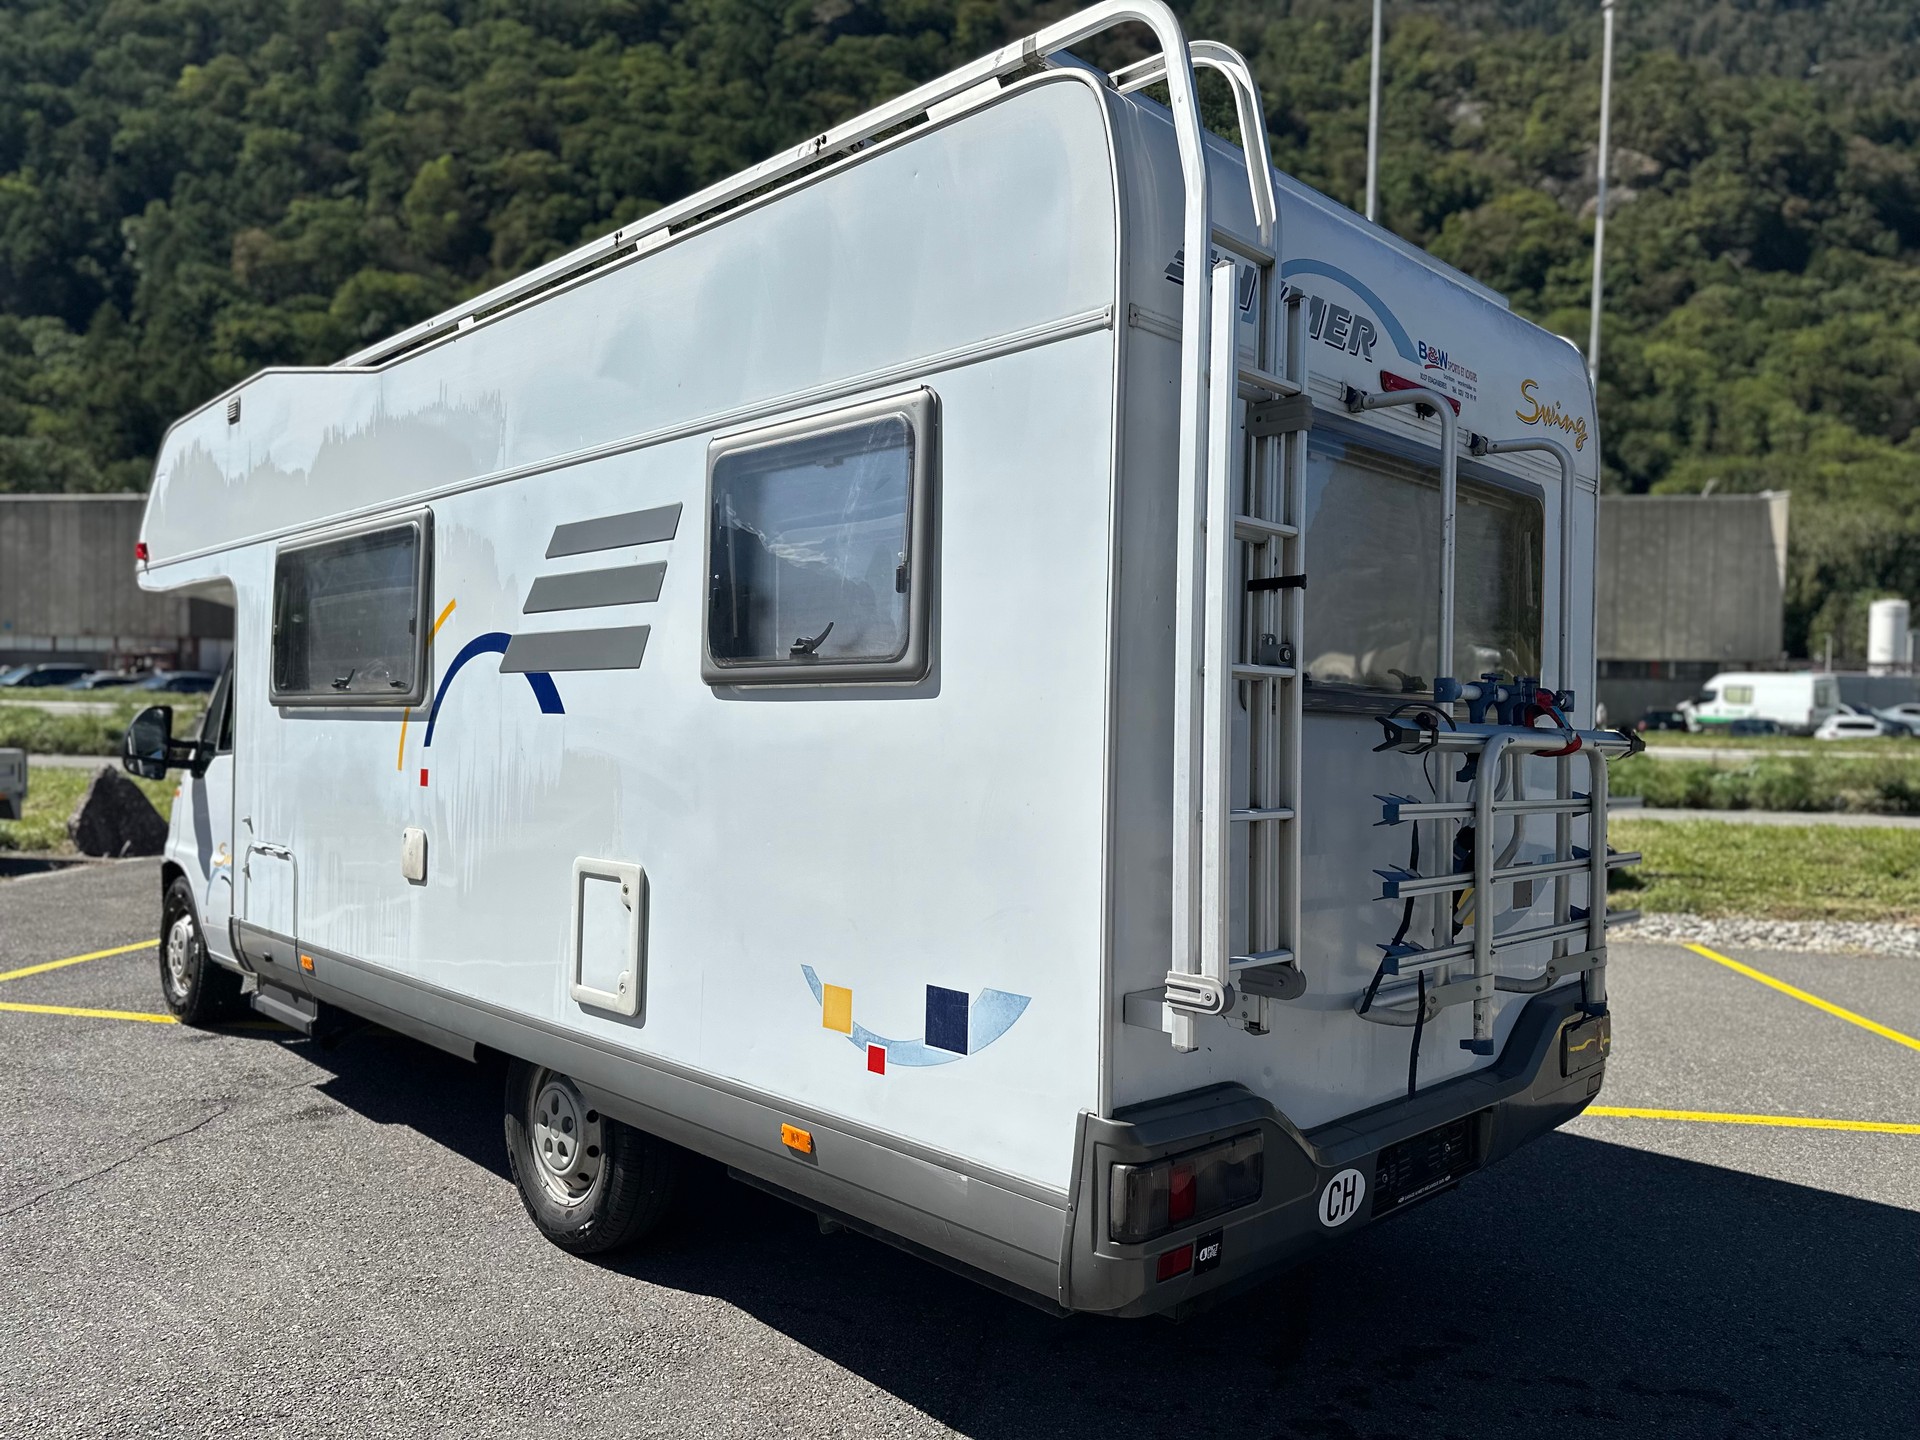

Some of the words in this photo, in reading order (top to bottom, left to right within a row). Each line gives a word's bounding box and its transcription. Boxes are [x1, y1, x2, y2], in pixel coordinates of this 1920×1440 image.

[1418, 340, 1448, 369] B&W
[1515, 379, 1588, 452] Swing
[1327, 1174, 1357, 1222] CH
